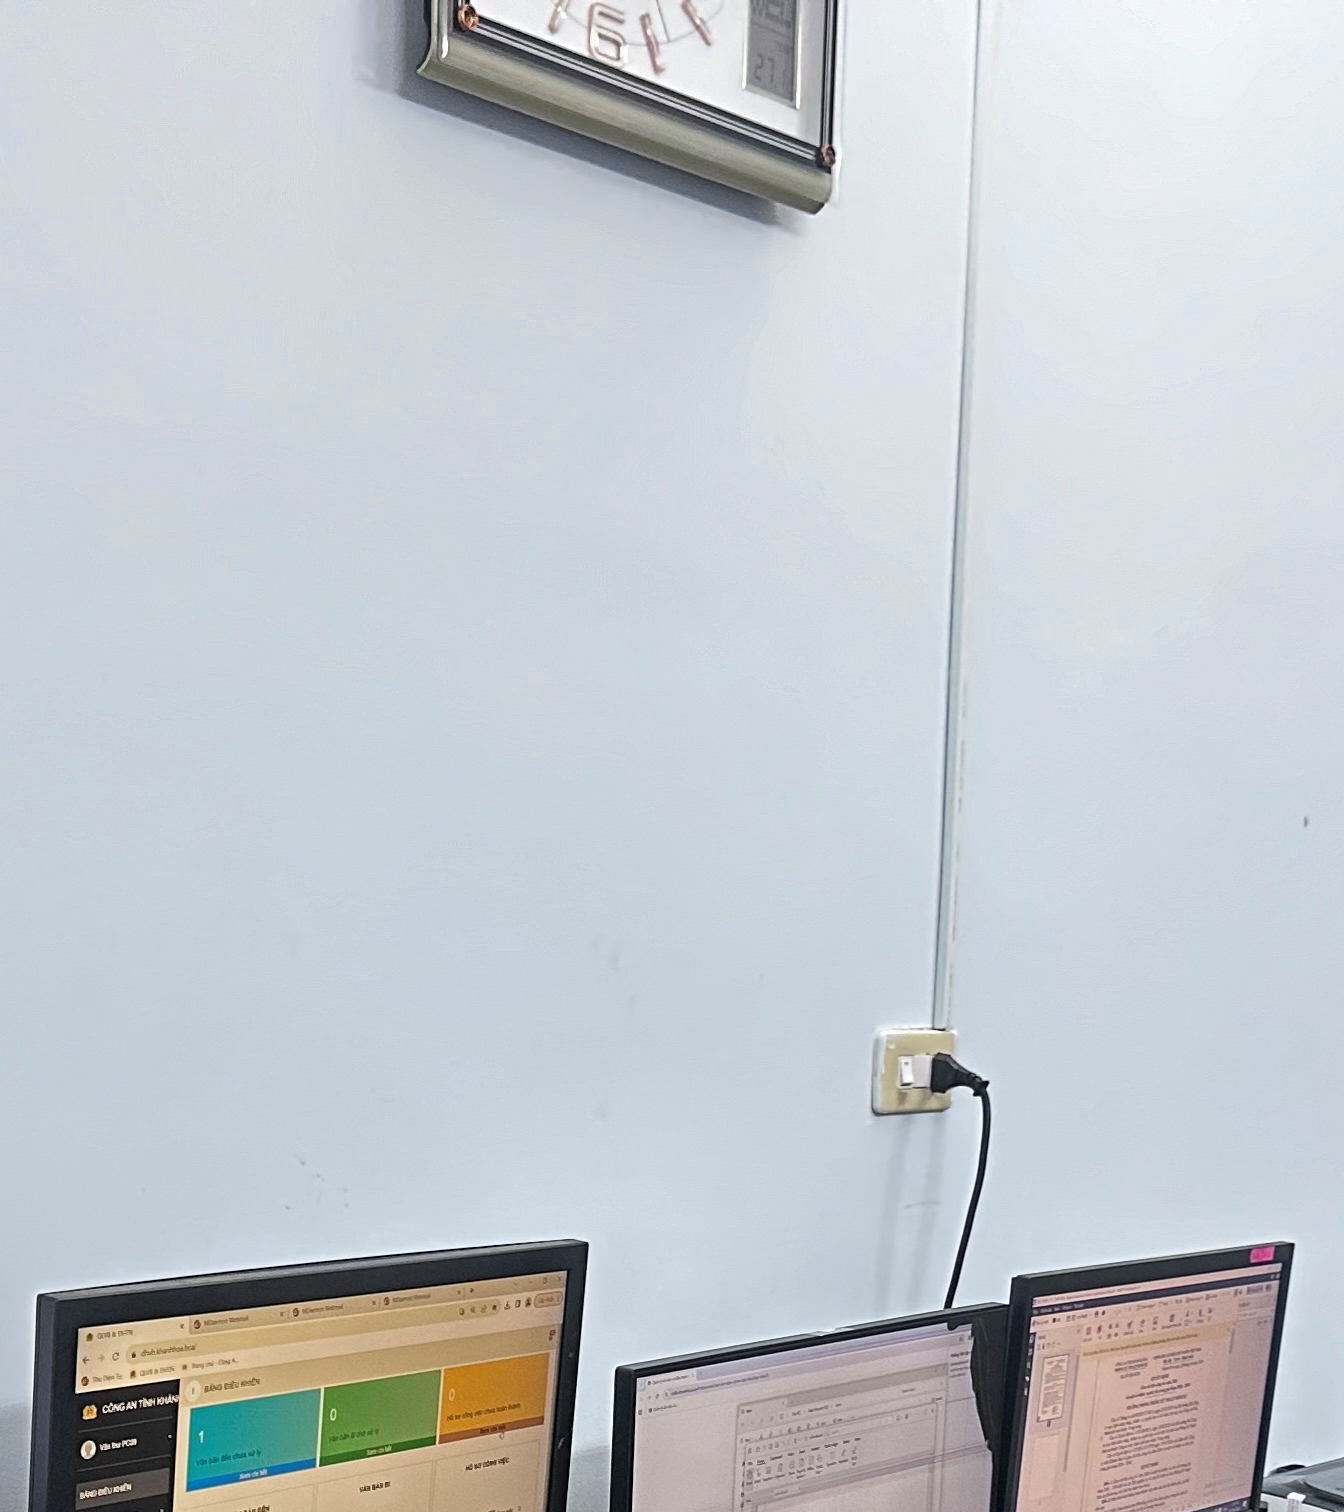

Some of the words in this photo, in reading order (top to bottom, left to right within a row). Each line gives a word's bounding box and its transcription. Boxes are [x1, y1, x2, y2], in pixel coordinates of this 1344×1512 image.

[102, 1402, 125, 1414] CÔNG
[126, 1400, 137, 1411] AN
[329, 1408, 337, 1421] 0
[198, 1430, 205, 1444] 1
